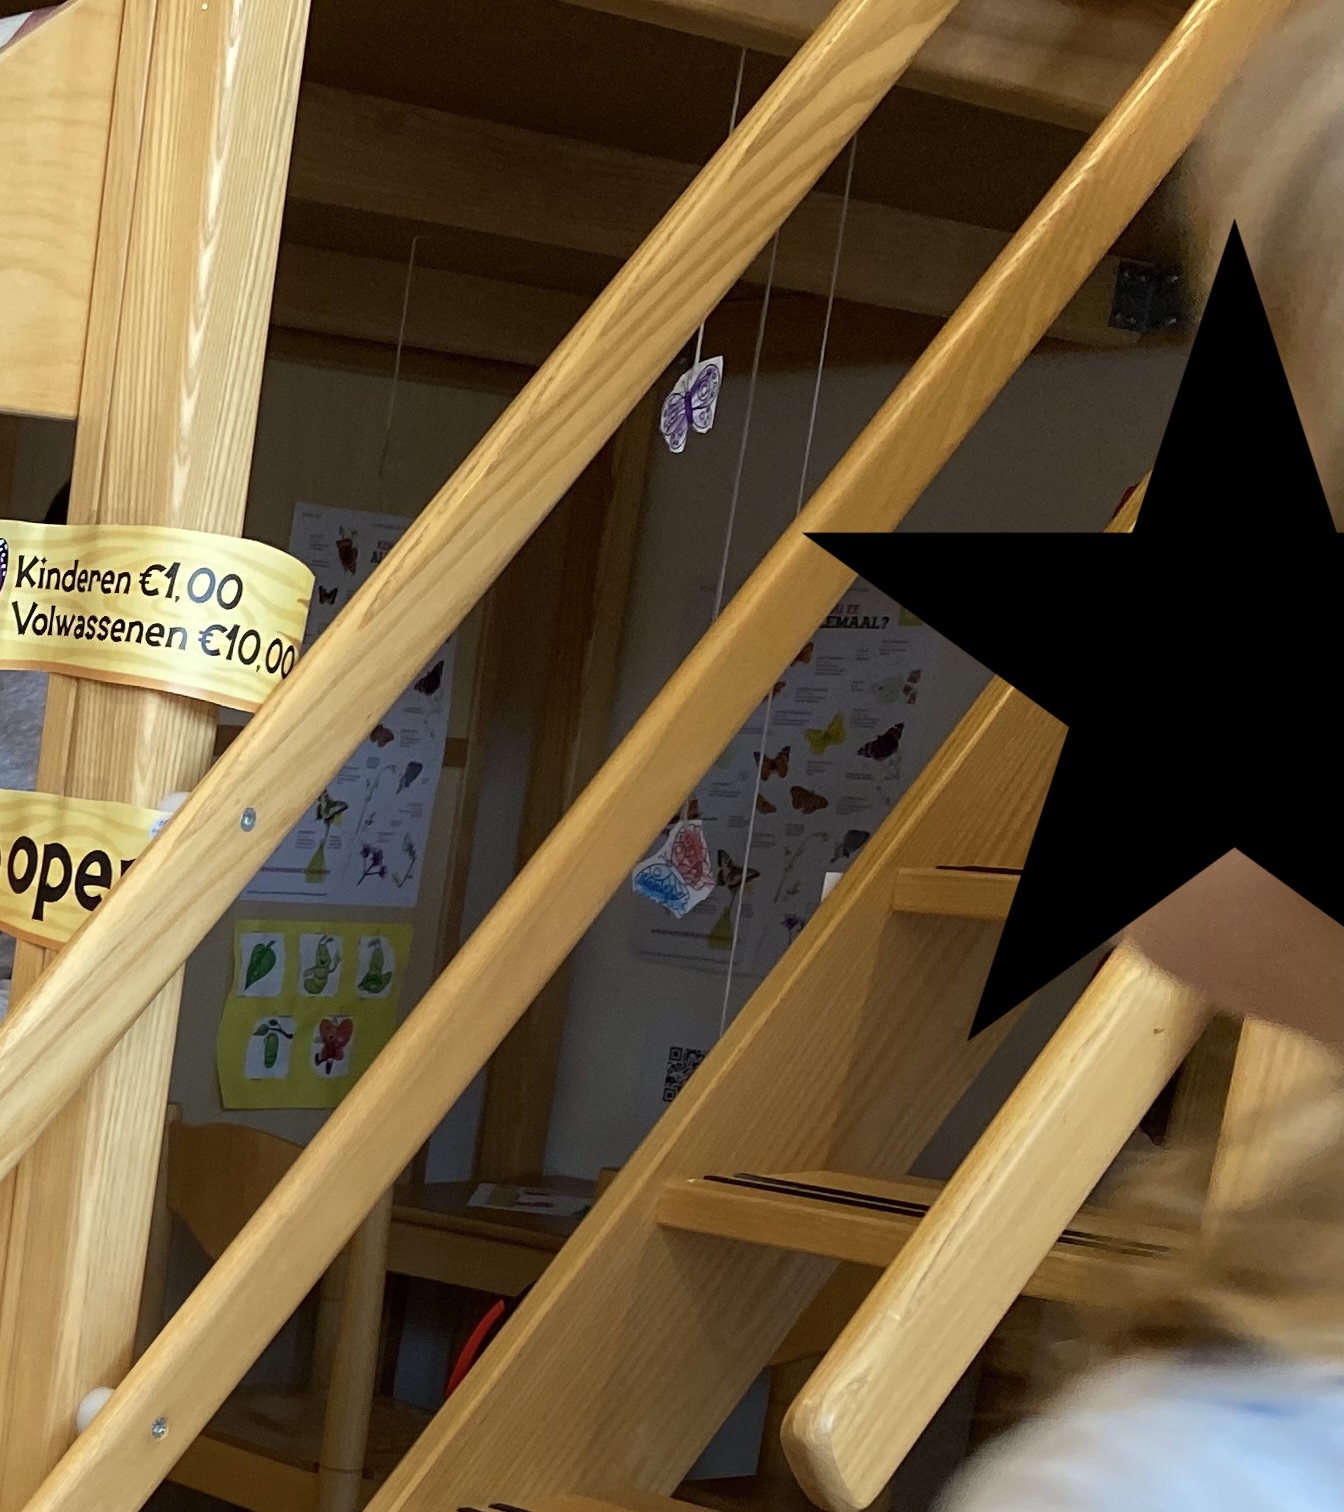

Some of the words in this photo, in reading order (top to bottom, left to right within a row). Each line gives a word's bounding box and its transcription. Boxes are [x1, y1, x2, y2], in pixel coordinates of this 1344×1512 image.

[15, 555, 132, 594] Kinderen
[139, 562, 243, 610] €1,00
[12, 601, 188, 651] Volwassenen
[198, 624, 295, 679] €10,00
[7, 836, 136, 921] ope
